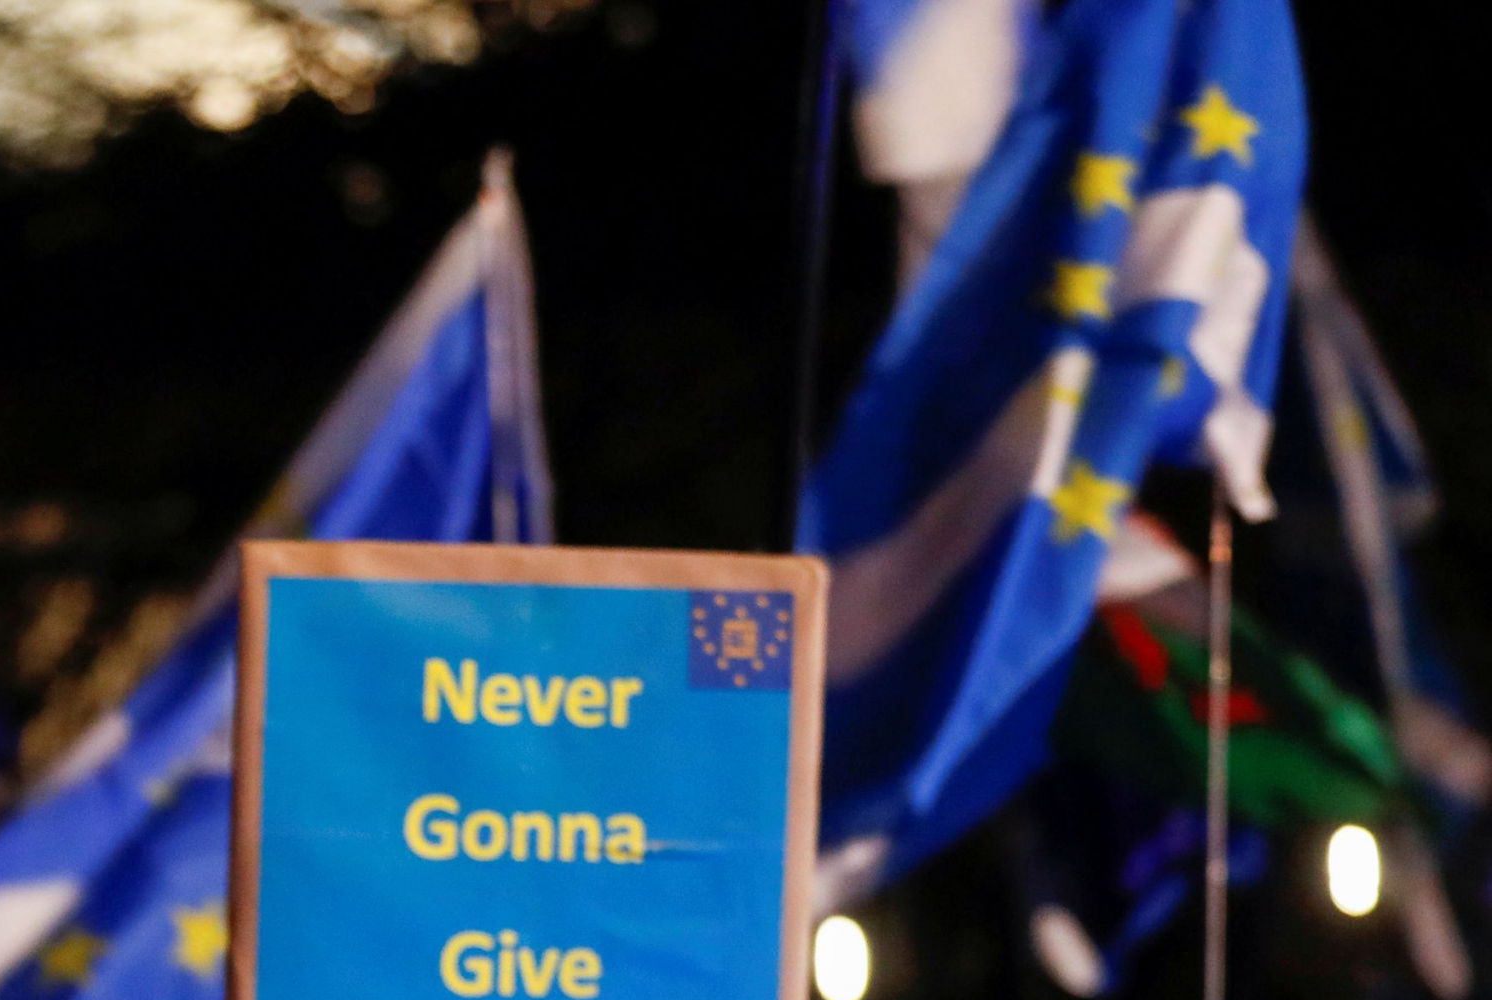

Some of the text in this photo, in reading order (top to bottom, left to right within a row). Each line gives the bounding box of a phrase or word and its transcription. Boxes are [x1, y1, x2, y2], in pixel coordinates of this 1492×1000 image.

[421, 657, 644, 729] Never
[402, 792, 649, 864] Gonna
[438, 929, 604, 1000] Give
